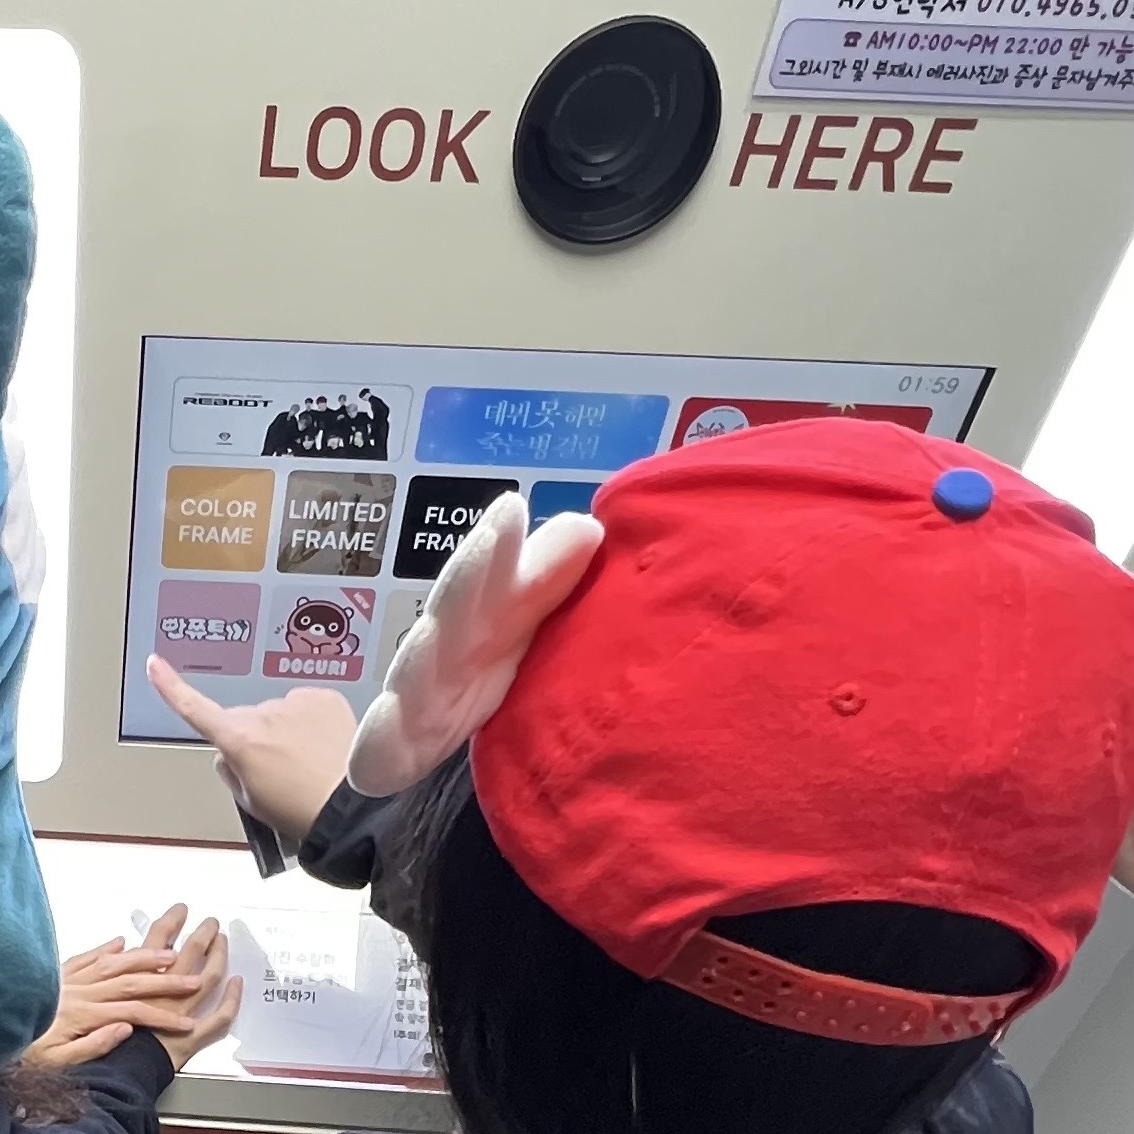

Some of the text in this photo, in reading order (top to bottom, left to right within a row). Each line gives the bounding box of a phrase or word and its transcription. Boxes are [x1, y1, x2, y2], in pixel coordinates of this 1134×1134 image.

[977, 0, 1134, 20] 010.4965.0
[1004, 37, 1063, 56] 22:00
[1069, 35, 1091, 60] 만
[1097, 35, 1134, 64] 가능
[852, 58, 869, 82] 및
[1014, 64, 1048, 88] 증상
[258, 105, 977, 194] LOOK HERE
[898, 375, 960, 394] 01:59
[528, 398, 561, 429] 못
[180, 498, 257, 518] COLOR
[288, 499, 387, 523] LIMITED
[178, 524, 254, 545] FRAME
[291, 528, 376, 551] FRAME
[413, 532, 466, 552] FRA
[278, 657, 348, 676] DOGURI
[263, 987, 316, 1005] 선택하기
